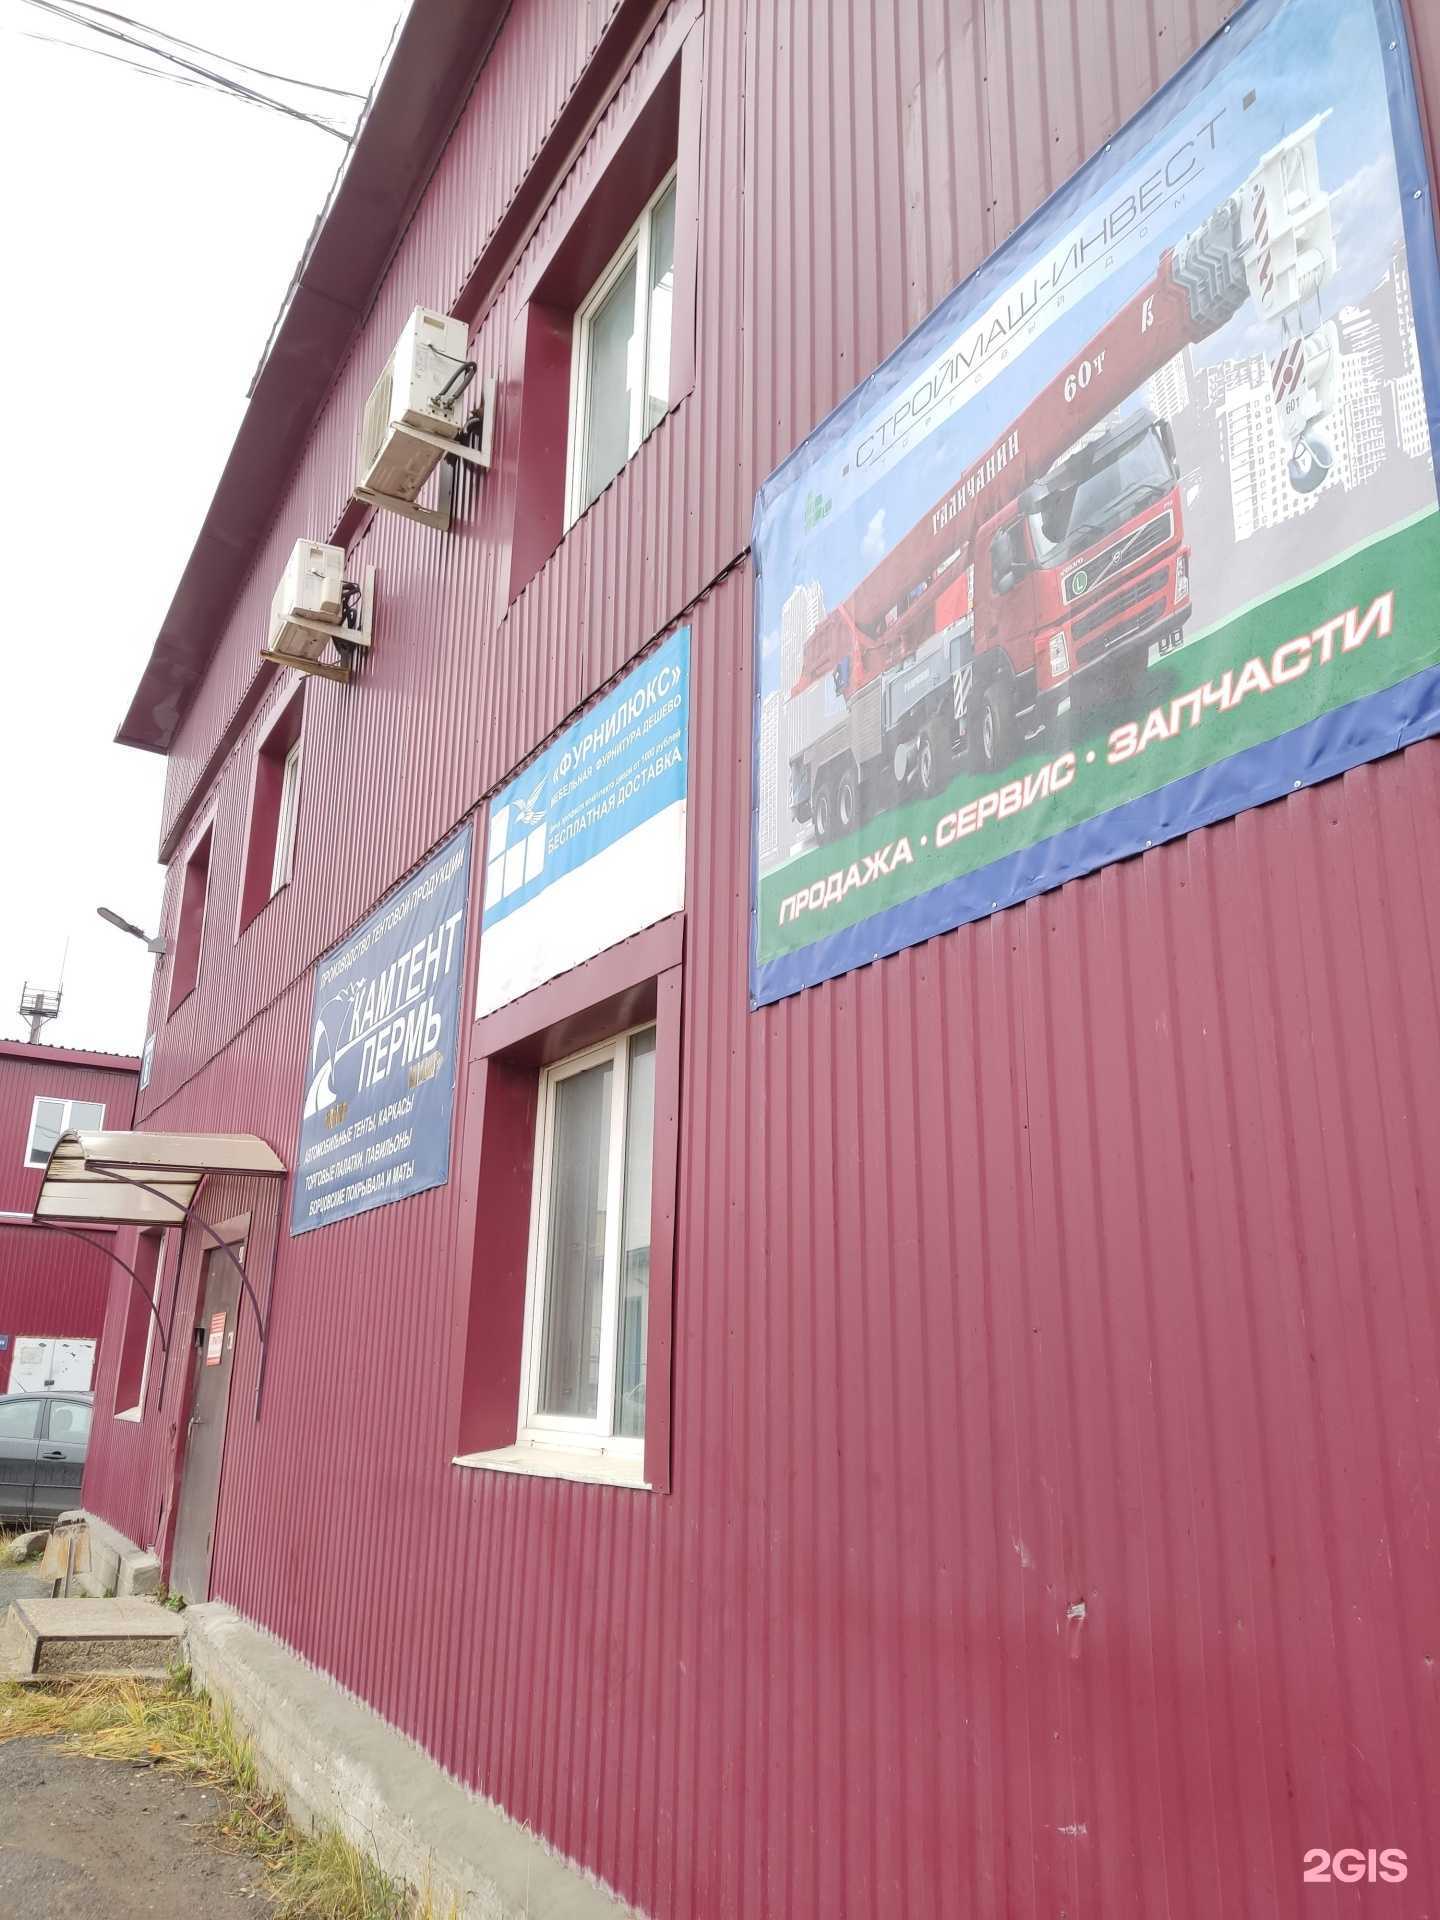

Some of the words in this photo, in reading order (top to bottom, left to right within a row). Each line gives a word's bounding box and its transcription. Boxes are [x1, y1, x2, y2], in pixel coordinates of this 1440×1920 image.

[856, 107, 1227, 468] СТРОЙМАШ-ИНВЕСТ
[642, 694, 682, 737] ДЕШЕВО
[778, 837, 914, 926] ПРОДАЖА
[935, 752, 1077, 848] СЕРВИС
[1106, 590, 1395, 765] ЗАПЧАСТИ
[548, 793, 616, 855] БЕСПЛАТНАЯ
[617, 746, 682, 806] ДОСТАВКА
[411, 847, 465, 909] ПРОДУКЦИИ
[349, 909, 463, 1042] КАМТЕНТ
[358, 996, 442, 1094] ПЕРМЬ
[365, 1127, 413, 1167] ПАВИЛЬОНЫ
[377, 1094, 415, 1127] КАРКАСЫ
